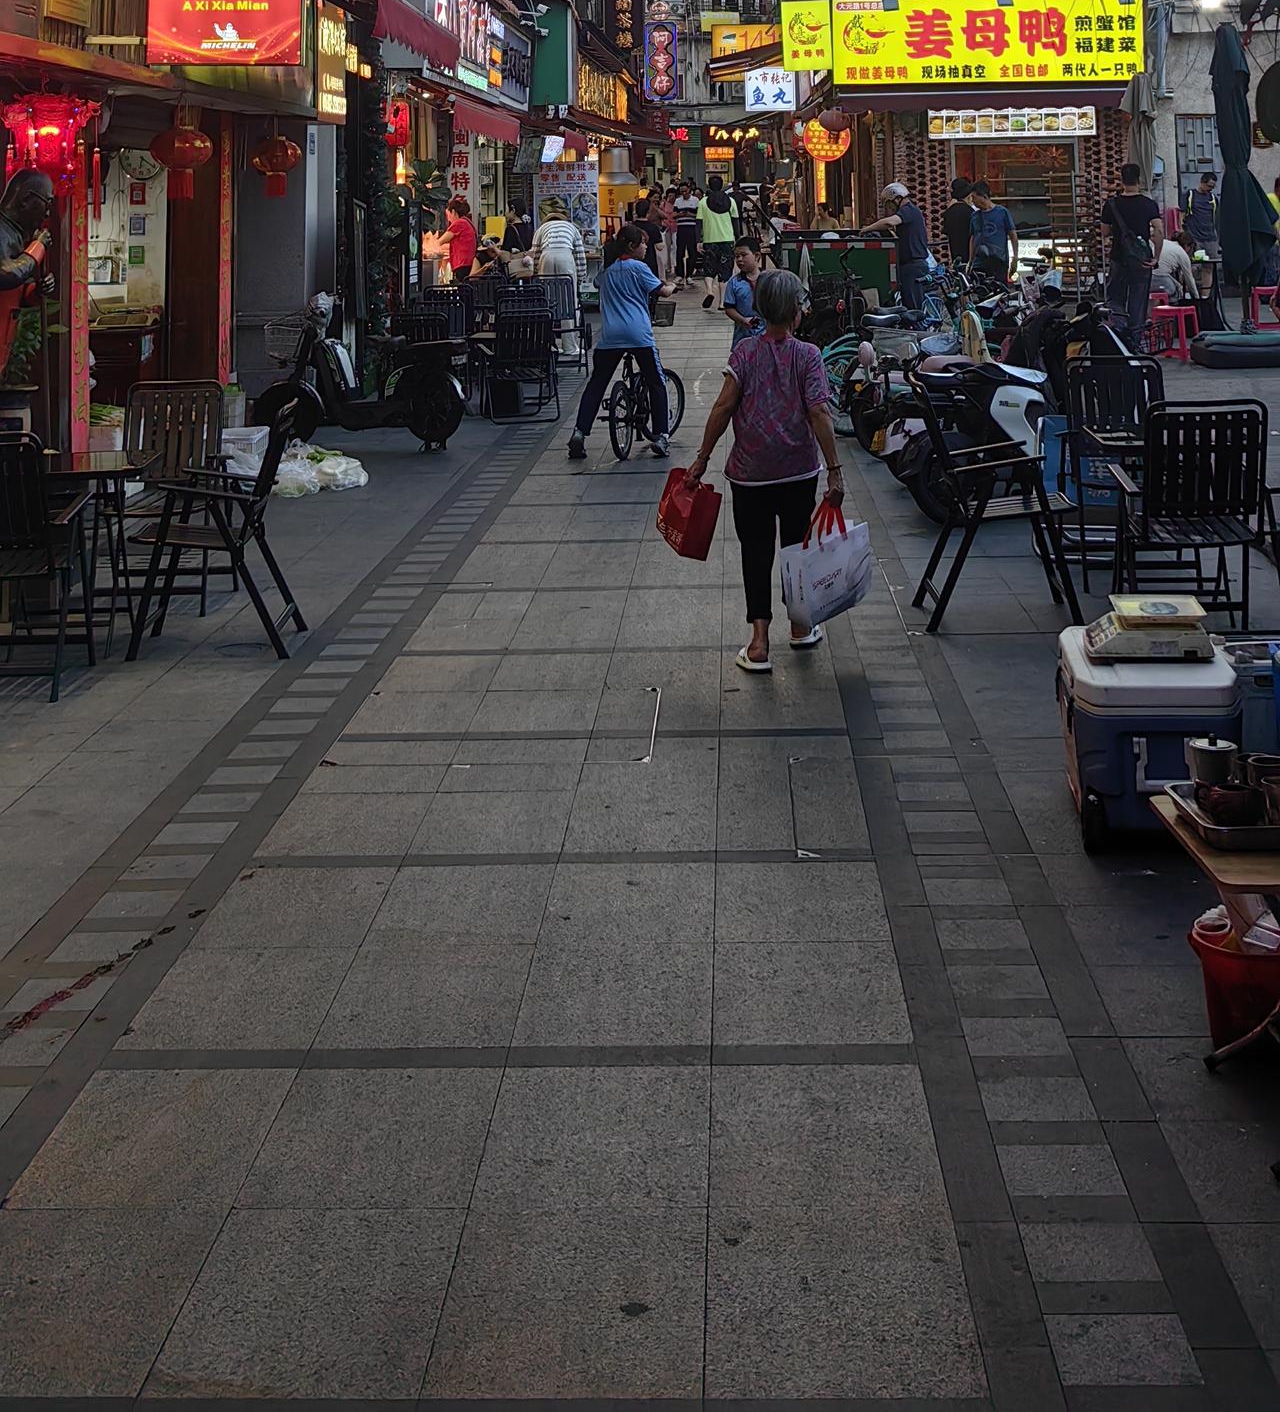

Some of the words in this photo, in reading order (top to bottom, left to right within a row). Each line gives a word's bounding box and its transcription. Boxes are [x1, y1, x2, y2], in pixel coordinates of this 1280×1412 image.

[182, 1, 192, 11] A
[195, 1, 209, 11] Xi
[212, 1, 234, 11] Xia
[236, 1, 269, 11] Mian
[1075, 15, 1136, 31] 煎蟹馆
[904, 6, 1067, 60] 姜母鸭
[1075, 37, 1136, 53] 福建菜
[791, 49, 825, 59] 姜母鸭
[846, 67, 908, 80] 现做姜母鸭
[922, 65, 986, 79] 现场抽真空
[1000, 64, 1049, 78] 全国包邮
[1062, 63, 1137, 77] 两代人一只鸭
[750, 86, 792, 106] 鱼丸
